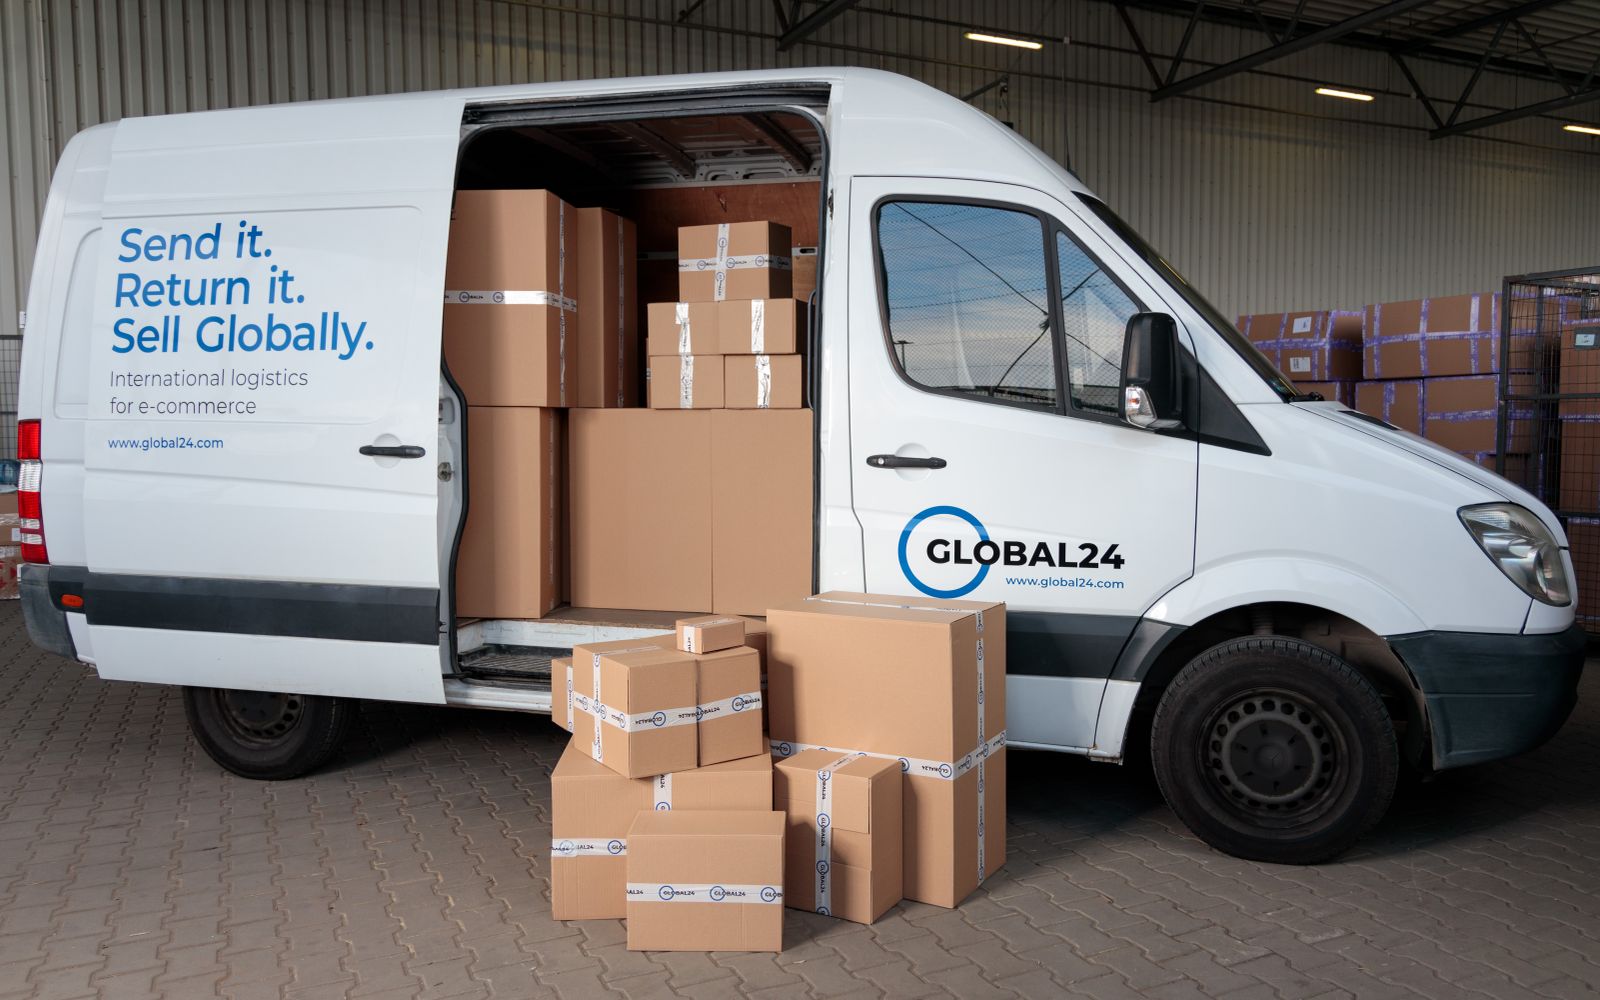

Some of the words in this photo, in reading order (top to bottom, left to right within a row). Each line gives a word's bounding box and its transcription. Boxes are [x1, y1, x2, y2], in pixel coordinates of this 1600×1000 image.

[118, 223, 222, 263] Send
[236, 220, 272, 259] it.
[115, 272, 250, 308] Return
[267, 265, 305, 304] it.
[112, 315, 180, 354] Sell
[196, 311, 374, 361] Globally.
[110, 369, 225, 388] International
[231, 368, 308, 391] logistics
[110, 397, 133, 415] for
[138, 399, 257, 415] e-commerce
[108, 437, 224, 451] www.global24.com
[926, 538, 1125, 570] GLOBAL24
[1006, 576, 1124, 589] www.global24.com
